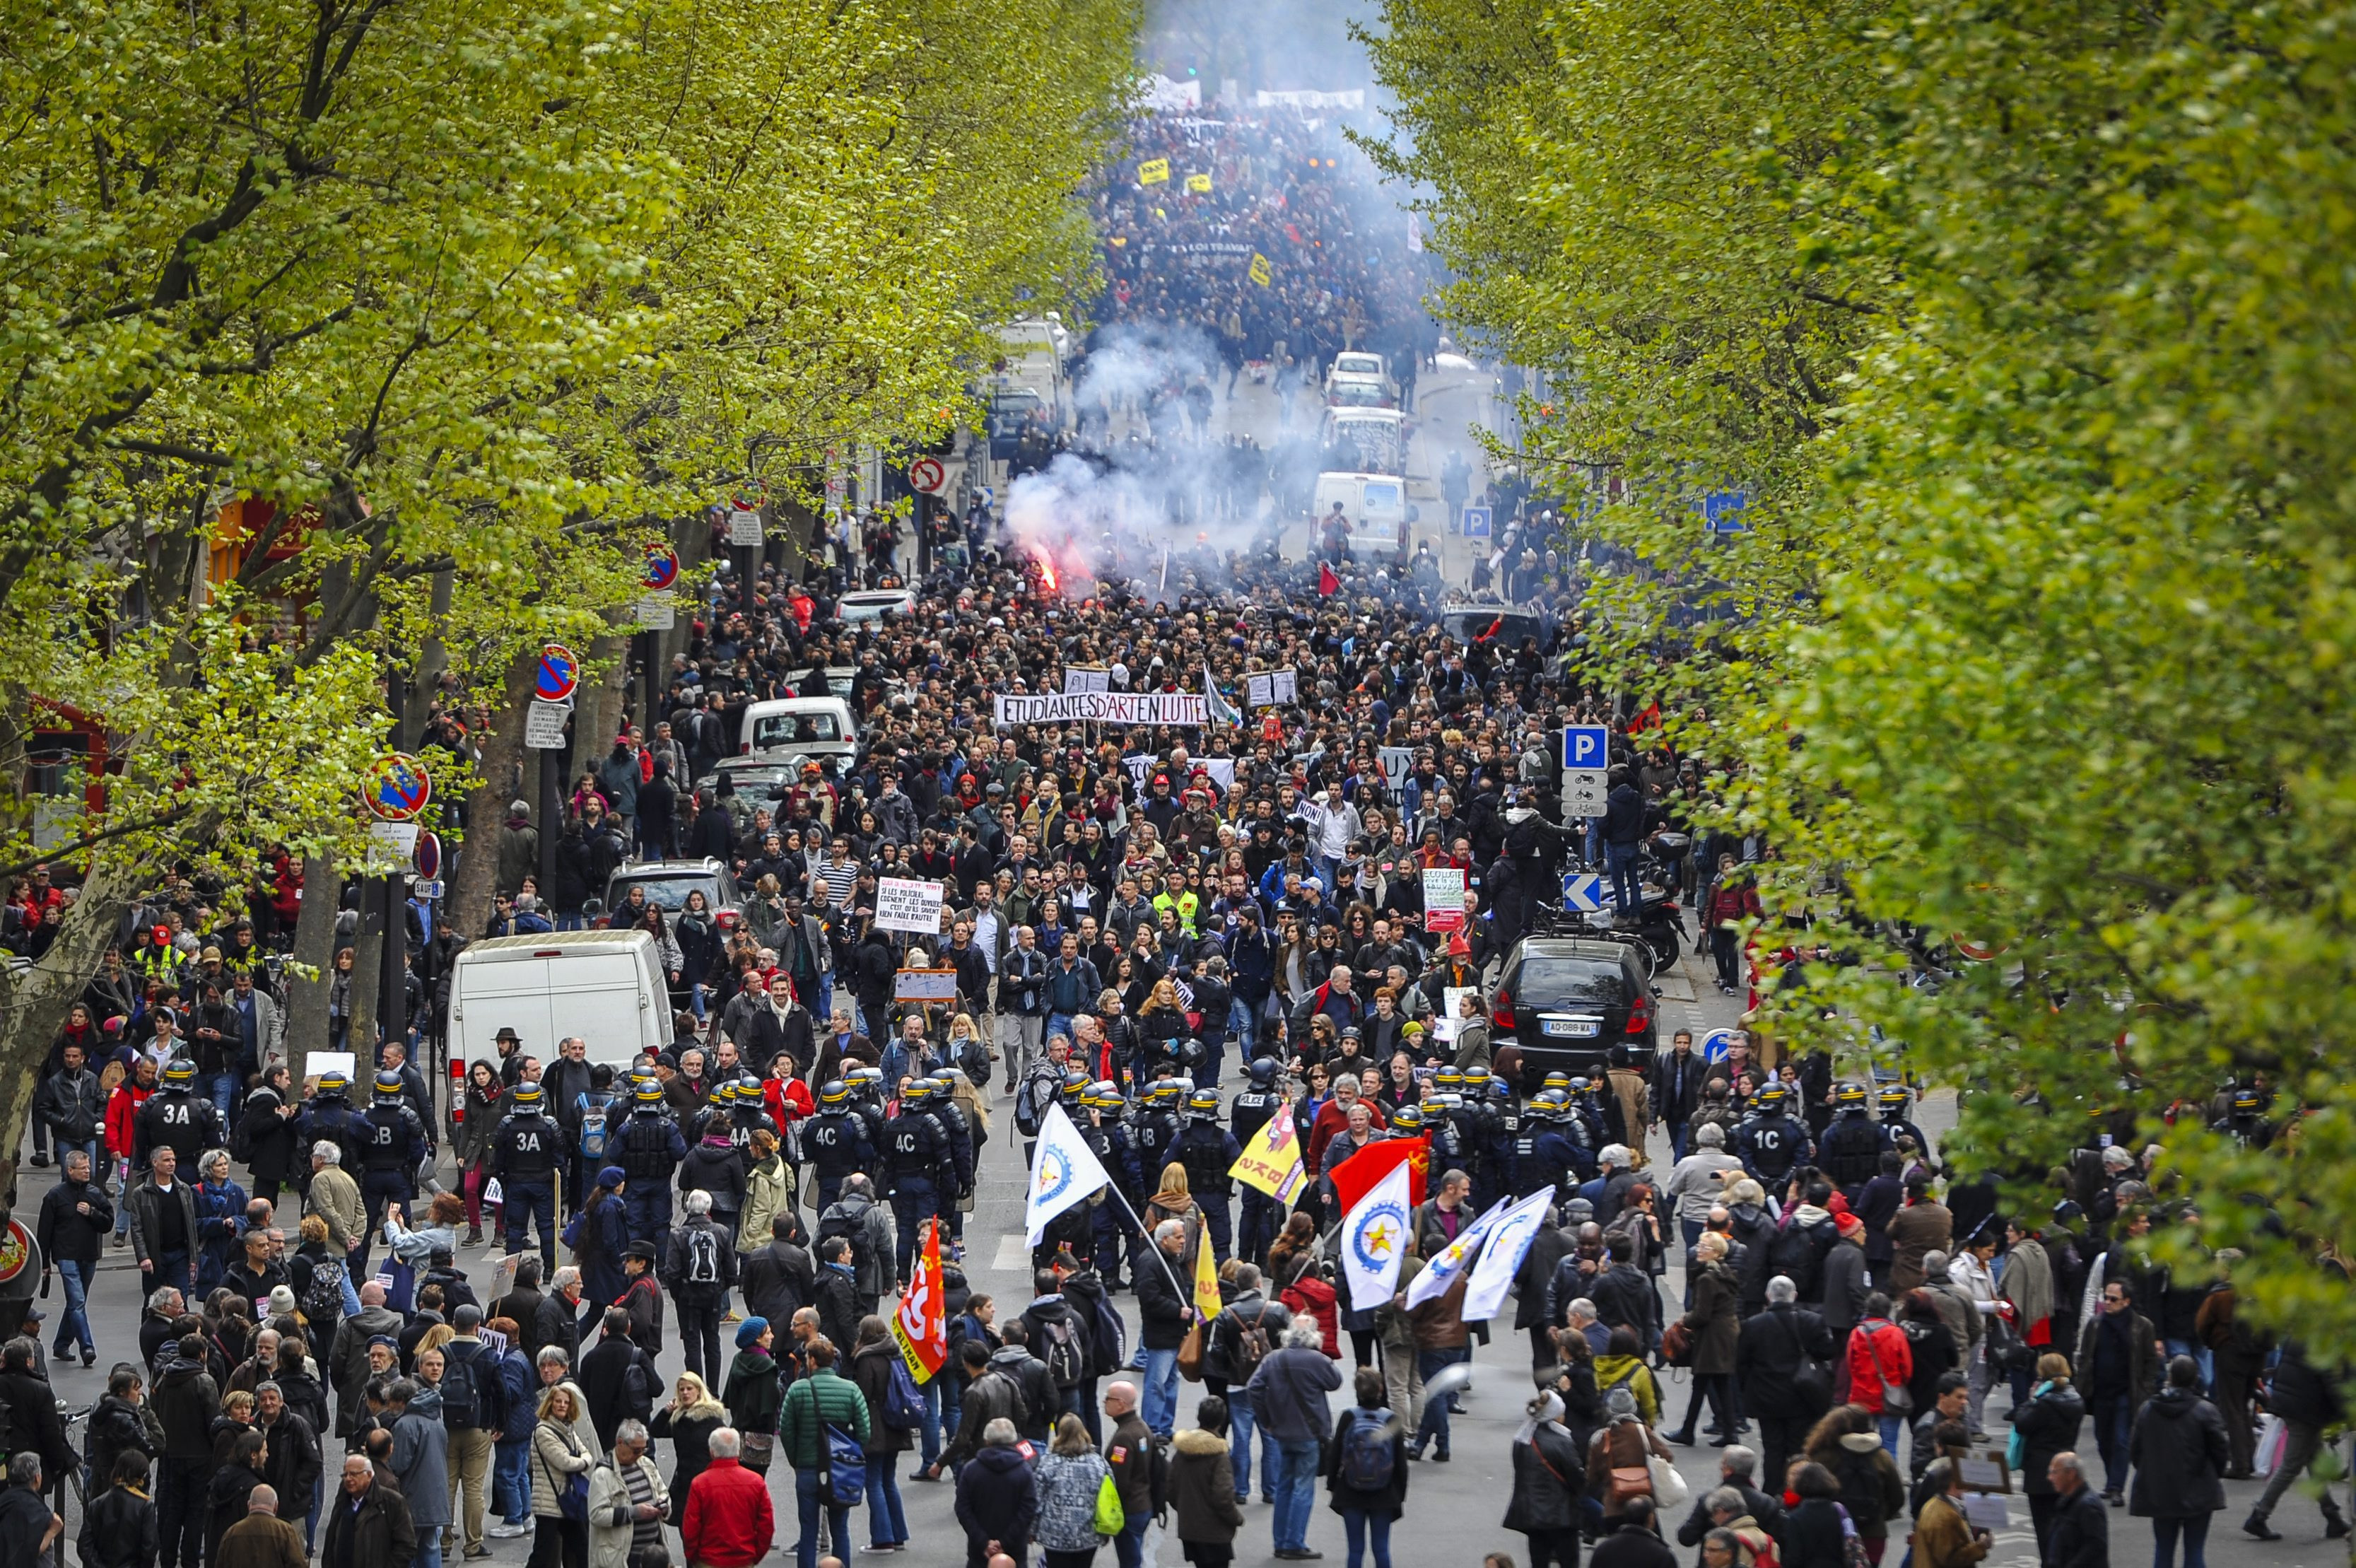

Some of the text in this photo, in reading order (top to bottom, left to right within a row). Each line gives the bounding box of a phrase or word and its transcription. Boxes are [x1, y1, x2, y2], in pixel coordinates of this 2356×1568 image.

[1470, 513, 1483, 532] P
[1576, 735, 1595, 762] P
[1299, 802, 1322, 823] NON!
[416, 883, 431, 894] SAUF
[1240, 1094, 1265, 1105] POLICE
[163, 1103, 190, 1125] 3A
[516, 1132, 541, 1152] 3A
[816, 1127, 836, 1145] 4C
[896, 1133, 915, 1152] 4C
[1754, 1130, 1779, 1149] 1C
